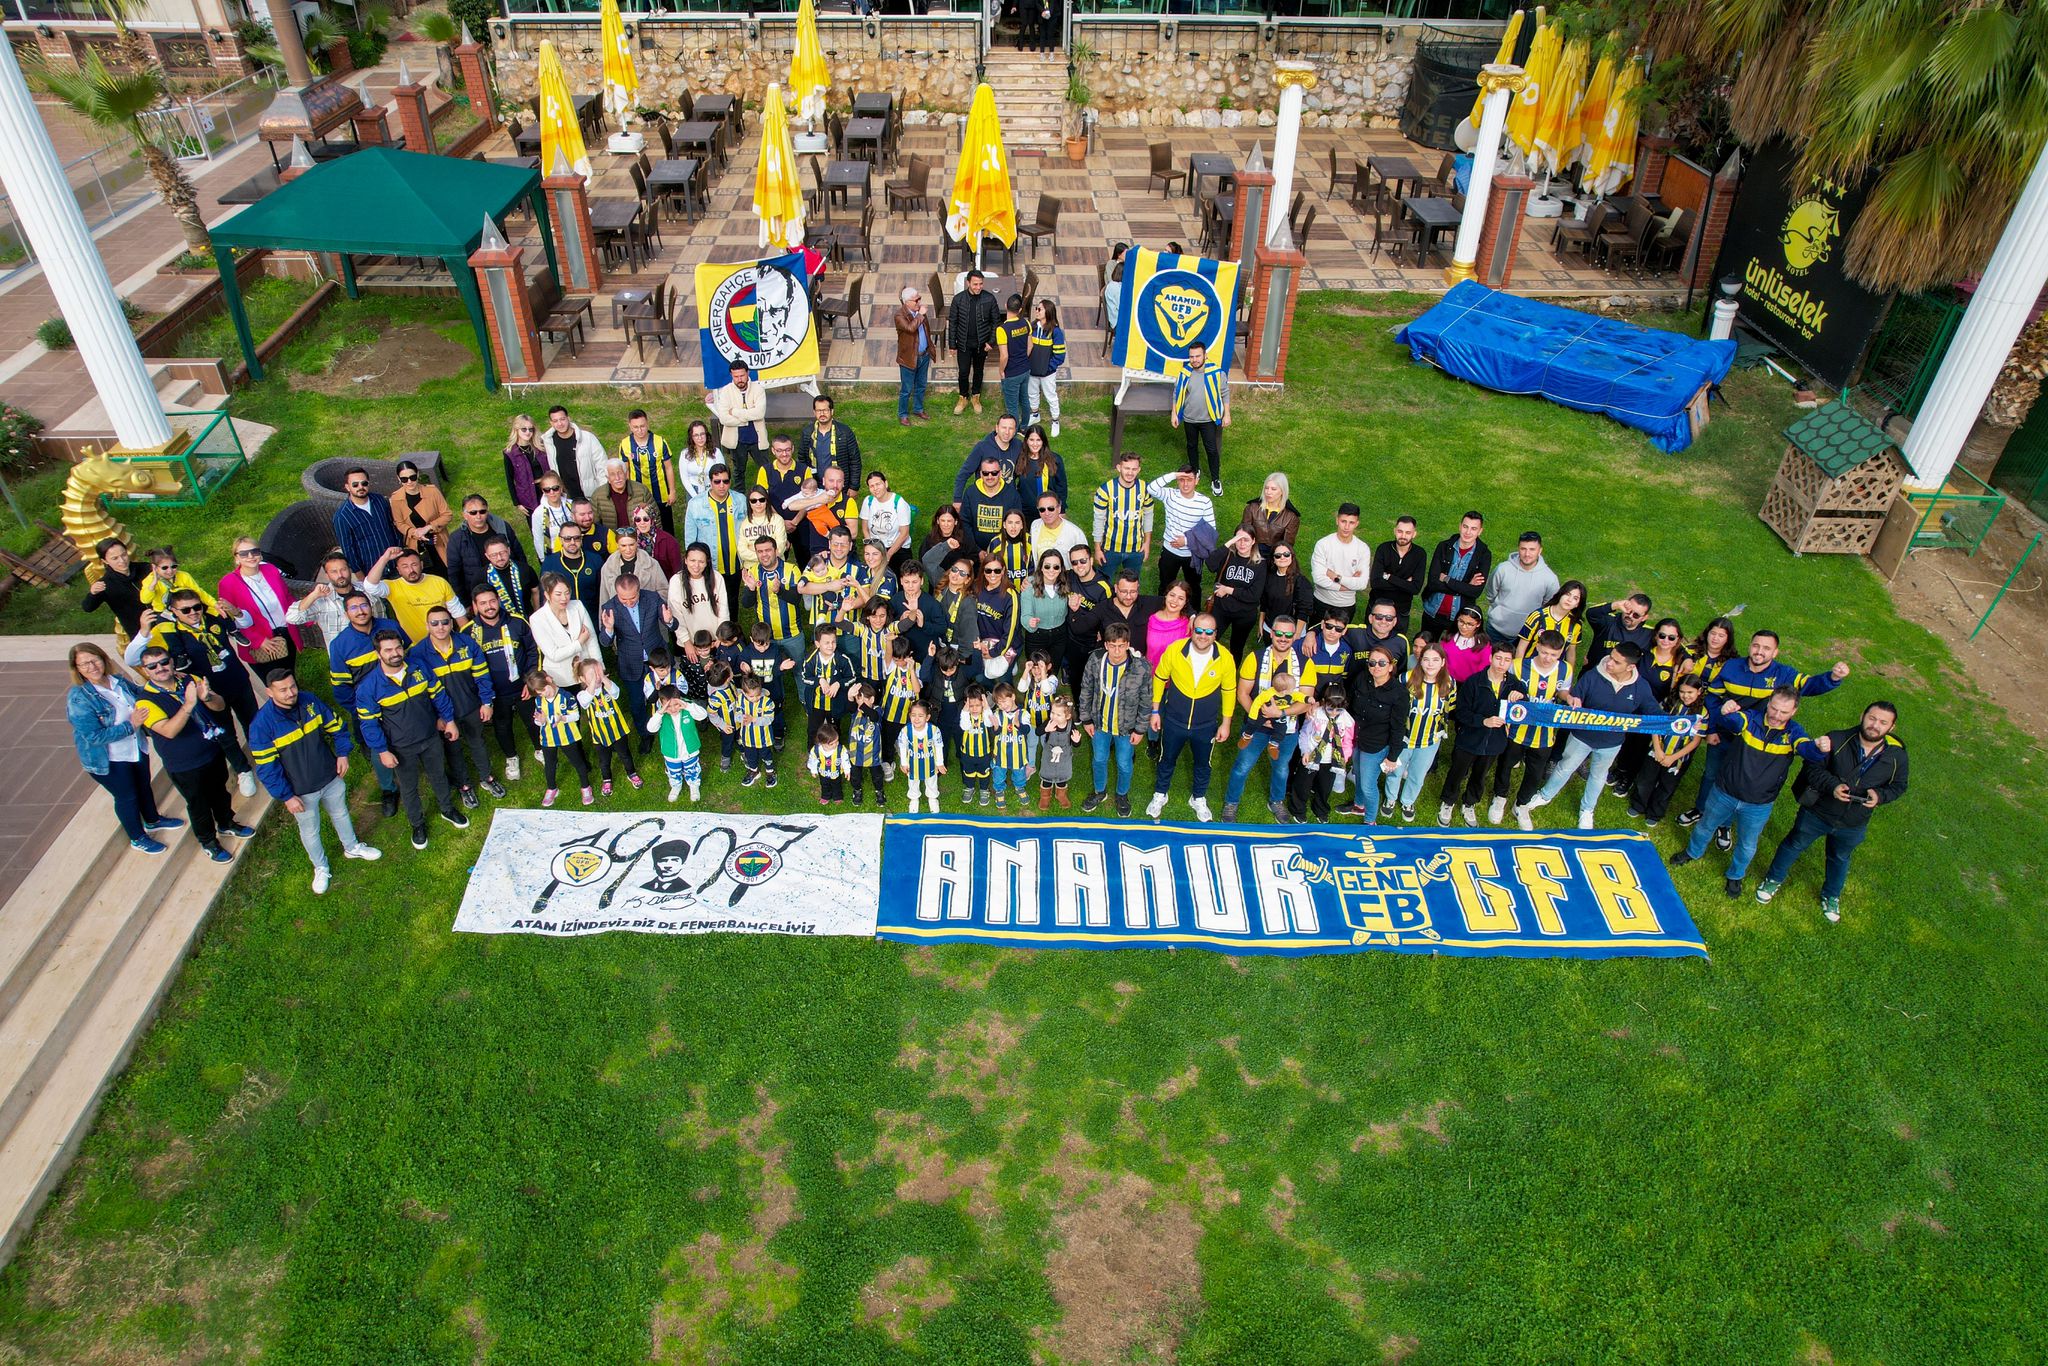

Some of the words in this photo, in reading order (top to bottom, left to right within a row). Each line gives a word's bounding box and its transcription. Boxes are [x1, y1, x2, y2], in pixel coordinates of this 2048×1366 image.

[1785, 263, 1810, 277] HOTEL
[1164, 293, 1202, 307] ANAMUR
[1745, 256, 1829, 334] ünlüselek
[712, 271, 753, 354] FENERBAHÇE
[1171, 303, 1192, 315] GFB
[1743, 283, 1760, 302] hotel
[1763, 296, 1797, 329] restaurant
[1801, 326, 1815, 341] bar
[748, 352, 773, 367] 1907
[979, 506, 1000, 516] FENER
[1226, 565, 1255, 583] GAP
[1553, 709, 1642, 731] FENERBAHÇE
[915, 834, 1320, 935] ANAMUR
[1442, 846, 1666, 936] GFB
[1343, 893, 1426, 929] FB
[511, 919, 558, 932] ATAM
[560, 917, 631, 933] İZİNDEYİZ
[632, 917, 656, 929] BİZ
[657, 921, 677, 930] DE
[679, 919, 816, 935] FENERBAHÇELİYİZ
